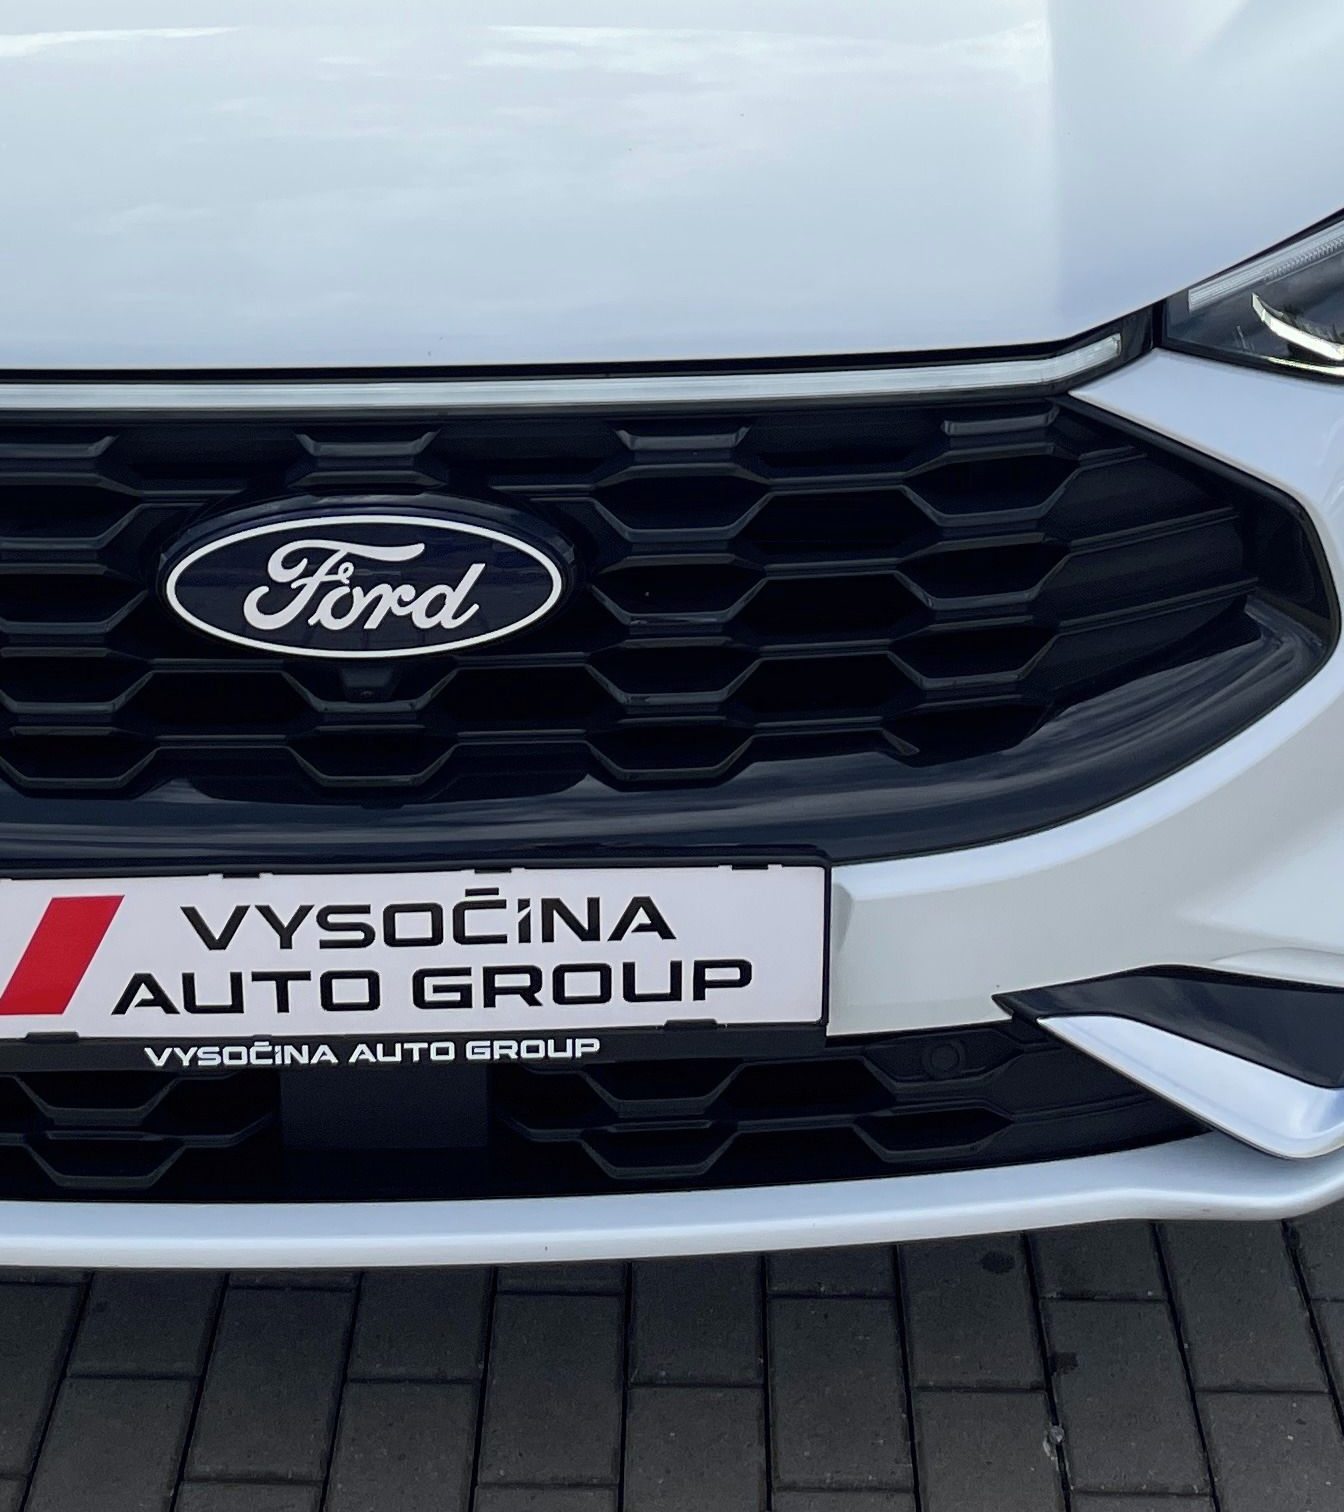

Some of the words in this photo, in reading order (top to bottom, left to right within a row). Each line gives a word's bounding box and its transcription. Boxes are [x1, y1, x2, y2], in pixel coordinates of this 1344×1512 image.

[243, 539, 486, 631] Ford
[179, 887, 678, 952] VYSOČINA
[110, 969, 382, 1017] AUTO
[411, 958, 754, 1011] GROUP
[144, 1041, 340, 1067] VYSOČINA
[348, 1041, 456, 1064] AUTO
[465, 1038, 602, 1061] GROUP
